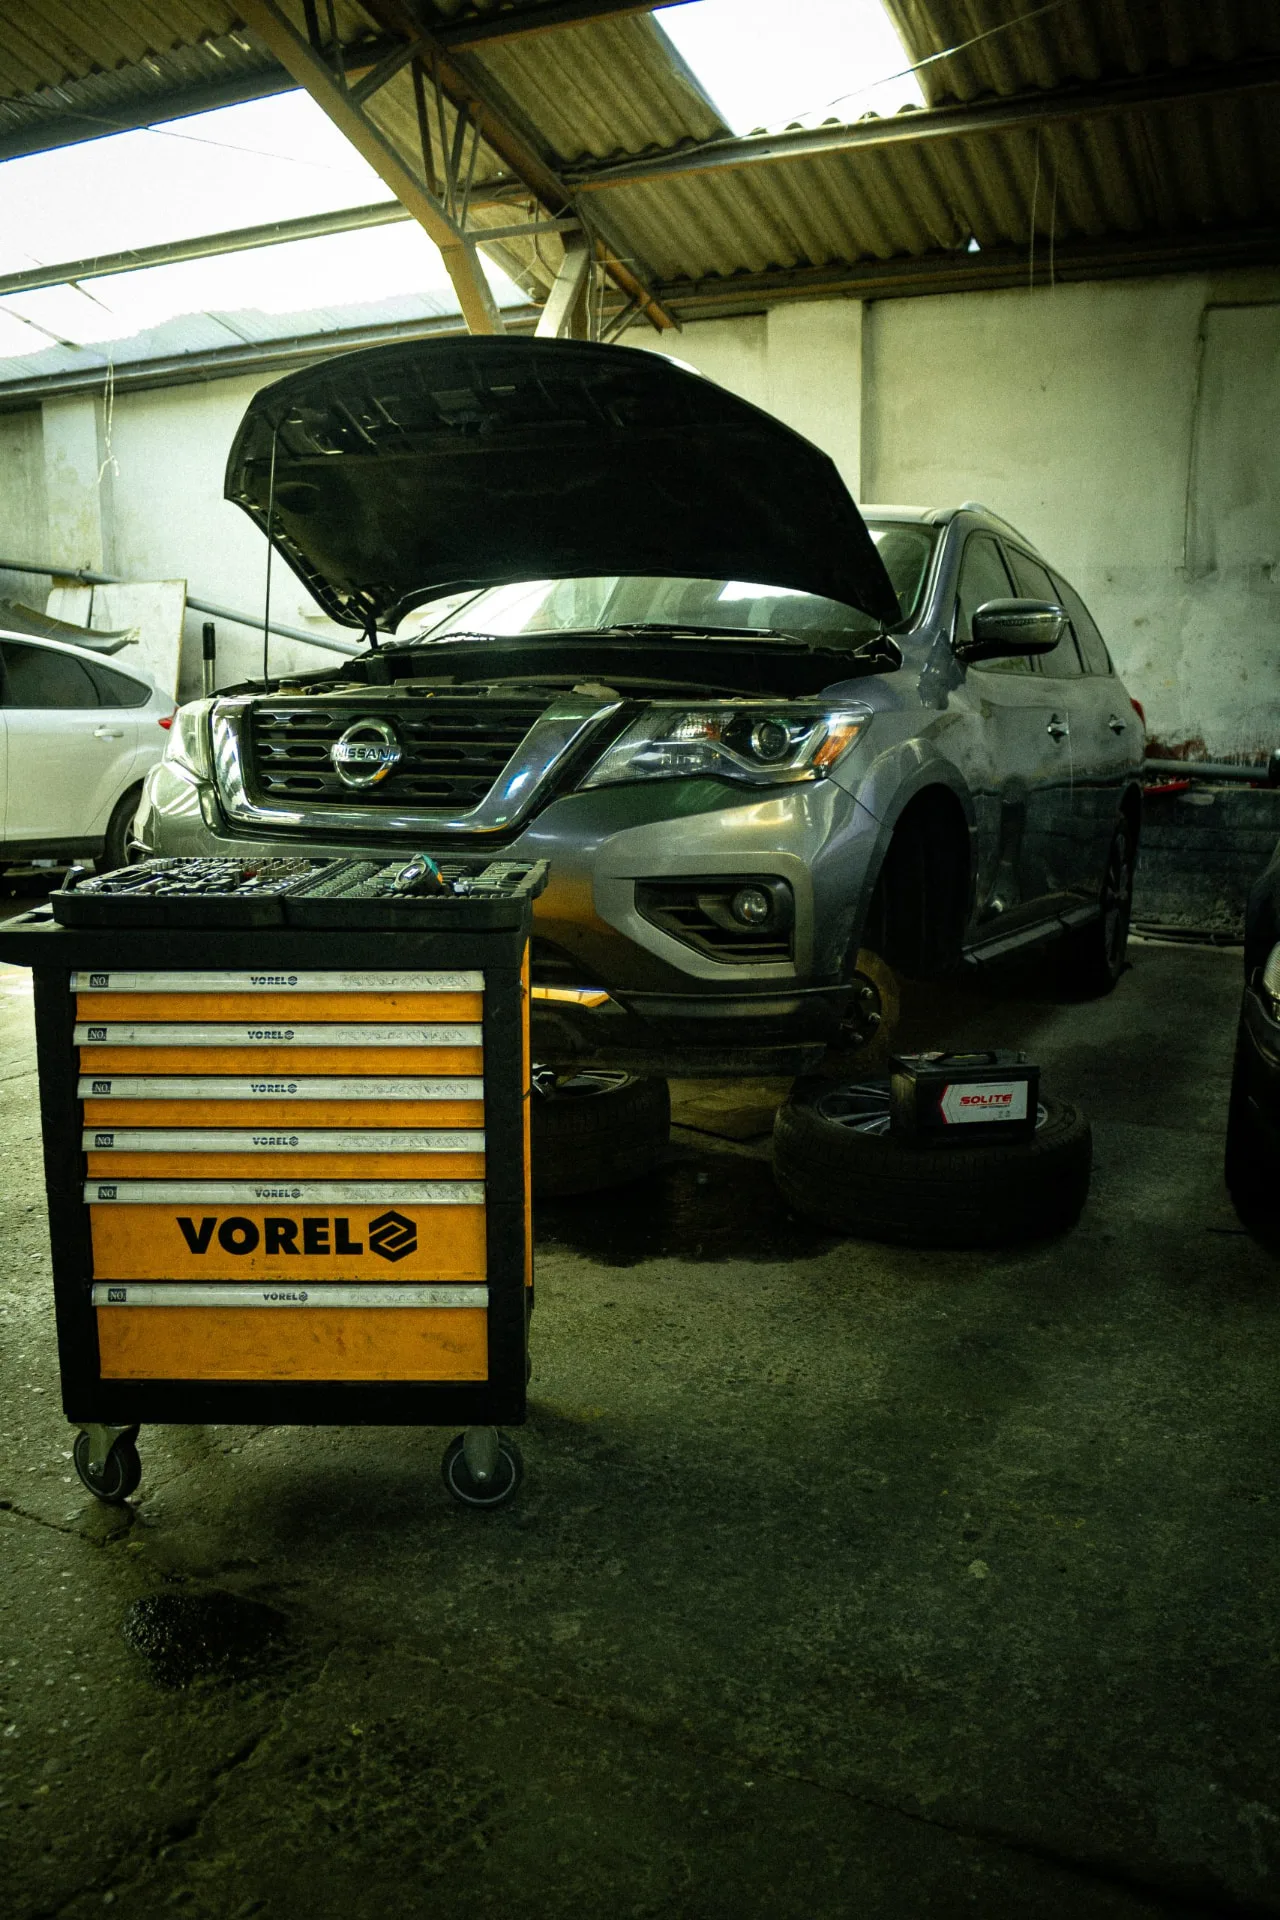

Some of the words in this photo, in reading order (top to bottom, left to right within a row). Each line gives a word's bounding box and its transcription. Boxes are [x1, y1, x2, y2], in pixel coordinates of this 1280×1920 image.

[336, 747, 391, 760] NISSAN
[91, 976, 108, 987] NO.
[250, 976, 287, 985] VOREL
[89, 1030, 106, 1040] NO.
[247, 1030, 284, 1040] VOREL
[94, 1083, 110, 1093] NO.
[250, 1084, 287, 1093] VOREL
[960, 1093, 1013, 1105] SOLITE
[97, 1136, 113, 1146] NO.
[252, 1137, 288, 1145] VOREL
[100, 1188, 116, 1198] NO.
[254, 1189, 290, 1198] VOREL
[176, 1216, 364, 1256] VOREL
[263, 1292, 298, 1301] VOREL
